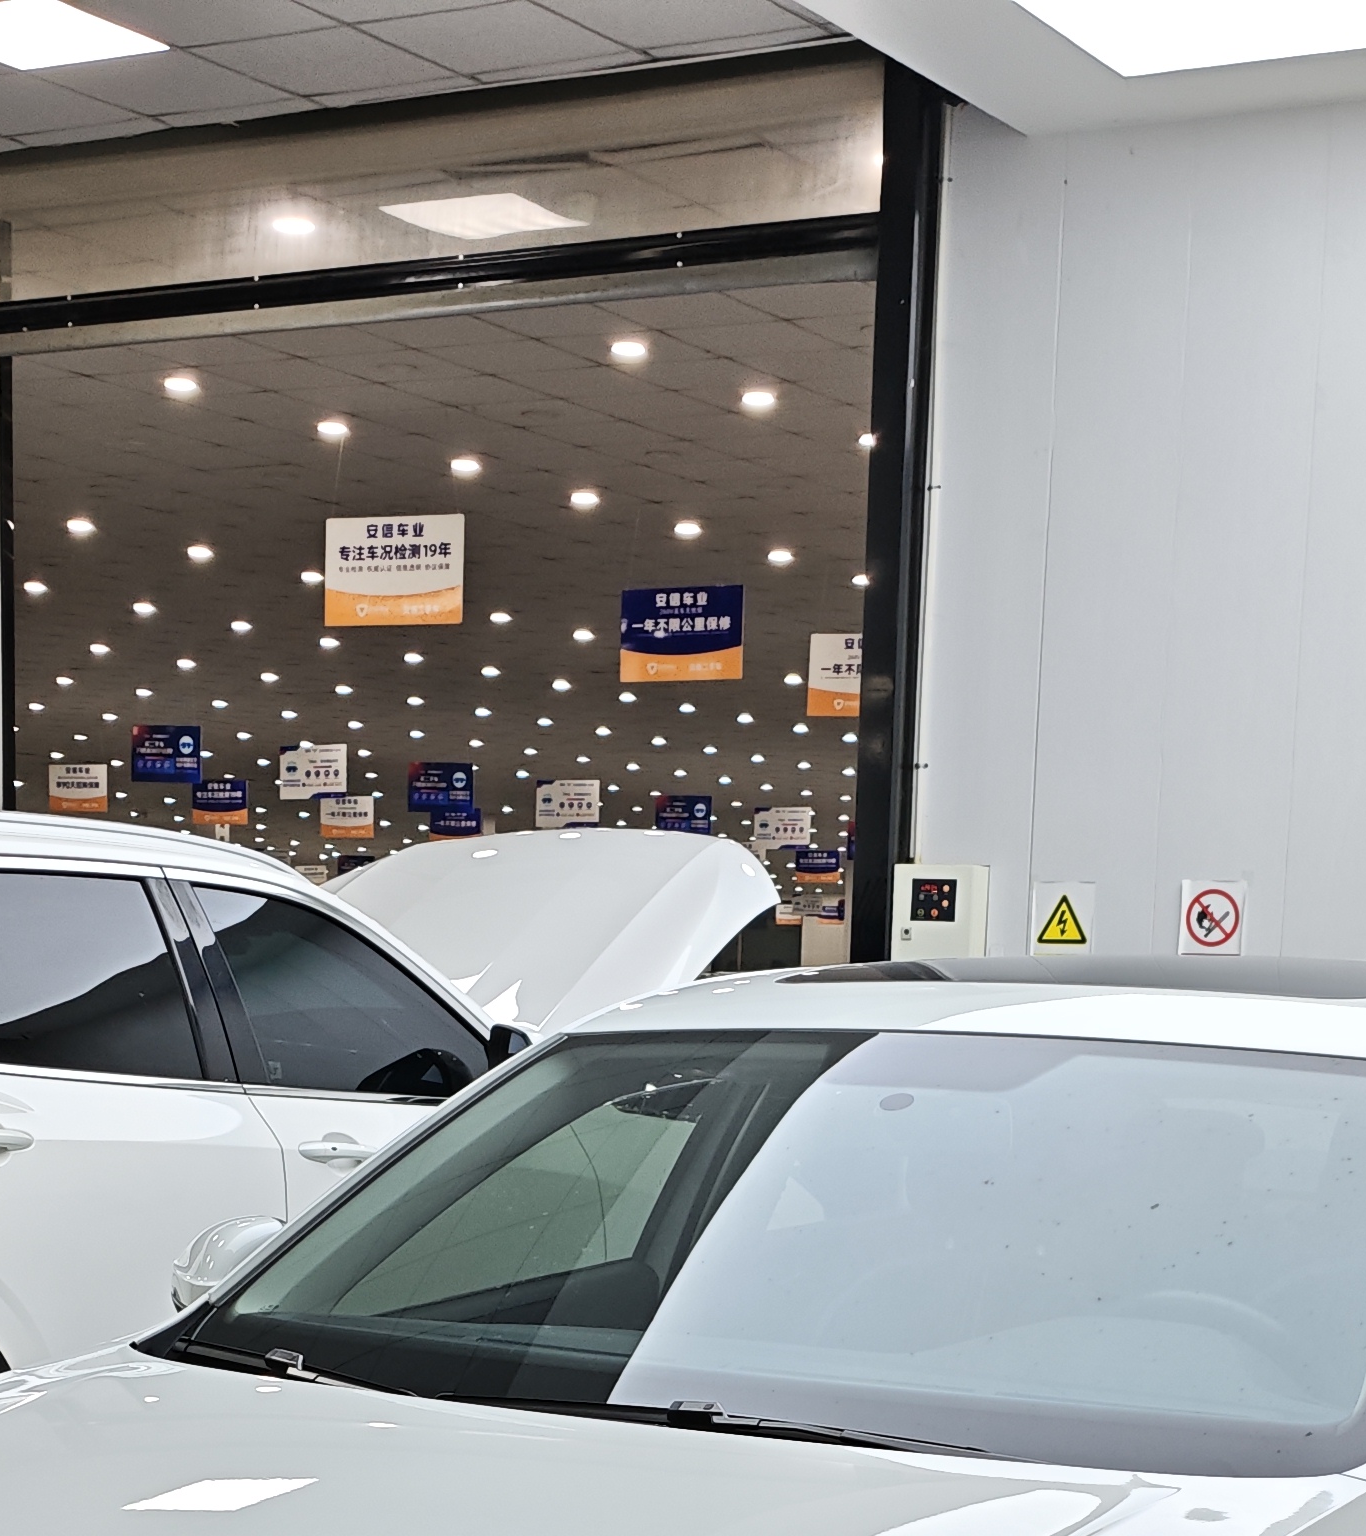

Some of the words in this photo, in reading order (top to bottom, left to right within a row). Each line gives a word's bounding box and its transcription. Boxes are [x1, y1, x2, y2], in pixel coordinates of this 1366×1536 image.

[366, 522, 425, 539] 安信车业
[338, 542, 452, 562] 专注车况检测19年
[655, 591, 708, 607] 安信车业
[631, 615, 732, 633] 一年不限公里保修
